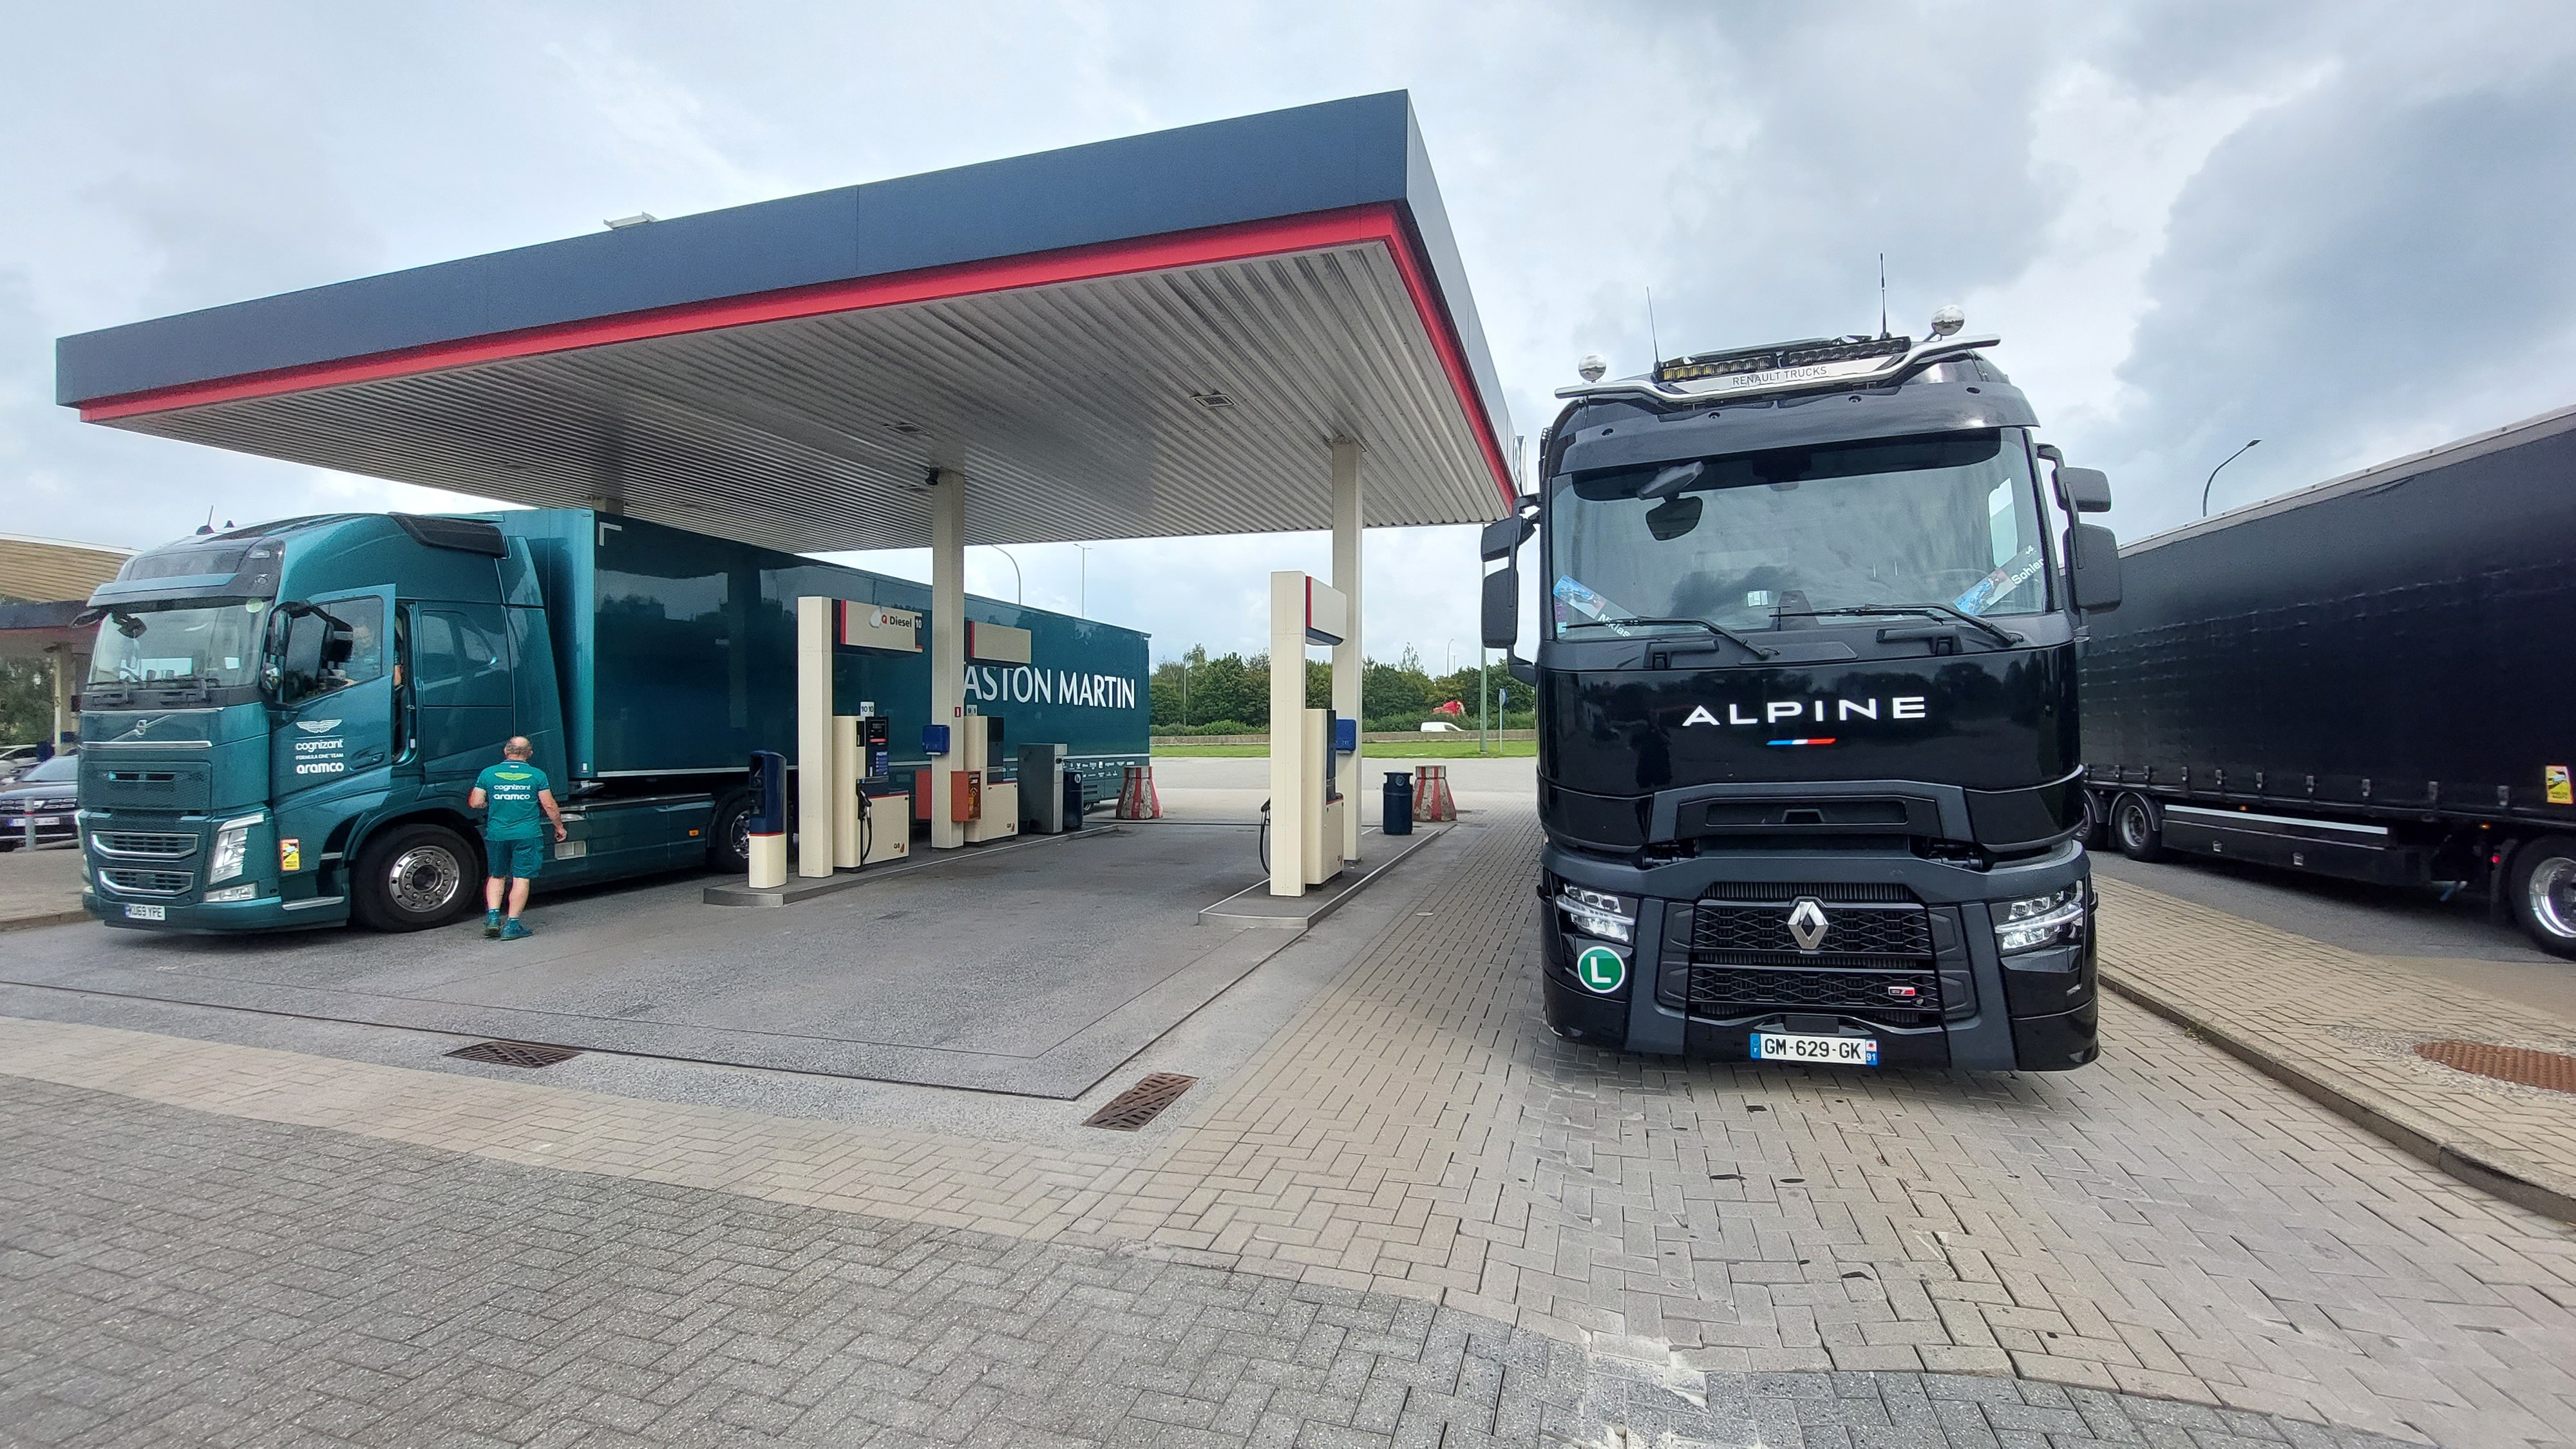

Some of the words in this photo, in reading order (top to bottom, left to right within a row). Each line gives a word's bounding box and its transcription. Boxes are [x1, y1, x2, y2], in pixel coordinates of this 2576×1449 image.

[1732, 372, 1781, 386] RENAULT
[1784, 366, 1827, 379] TRUCKS
[2011, 557, 2045, 585] Sohler
[889, 616, 912, 628] Diesel
[915, 618, 923, 629] 10
[963, 666, 1051, 703] ASTON
[1059, 670, 1135, 709] MARTIN
[1681, 696, 1926, 727] ALPINE
[296, 739, 345, 753] cognizant
[296, 762, 345, 774] aramco
[1590, 956, 1612, 984] L
[1764, 1037, 1861, 1059] GM-629-GK
[1866, 1052, 1877, 1061] 91
